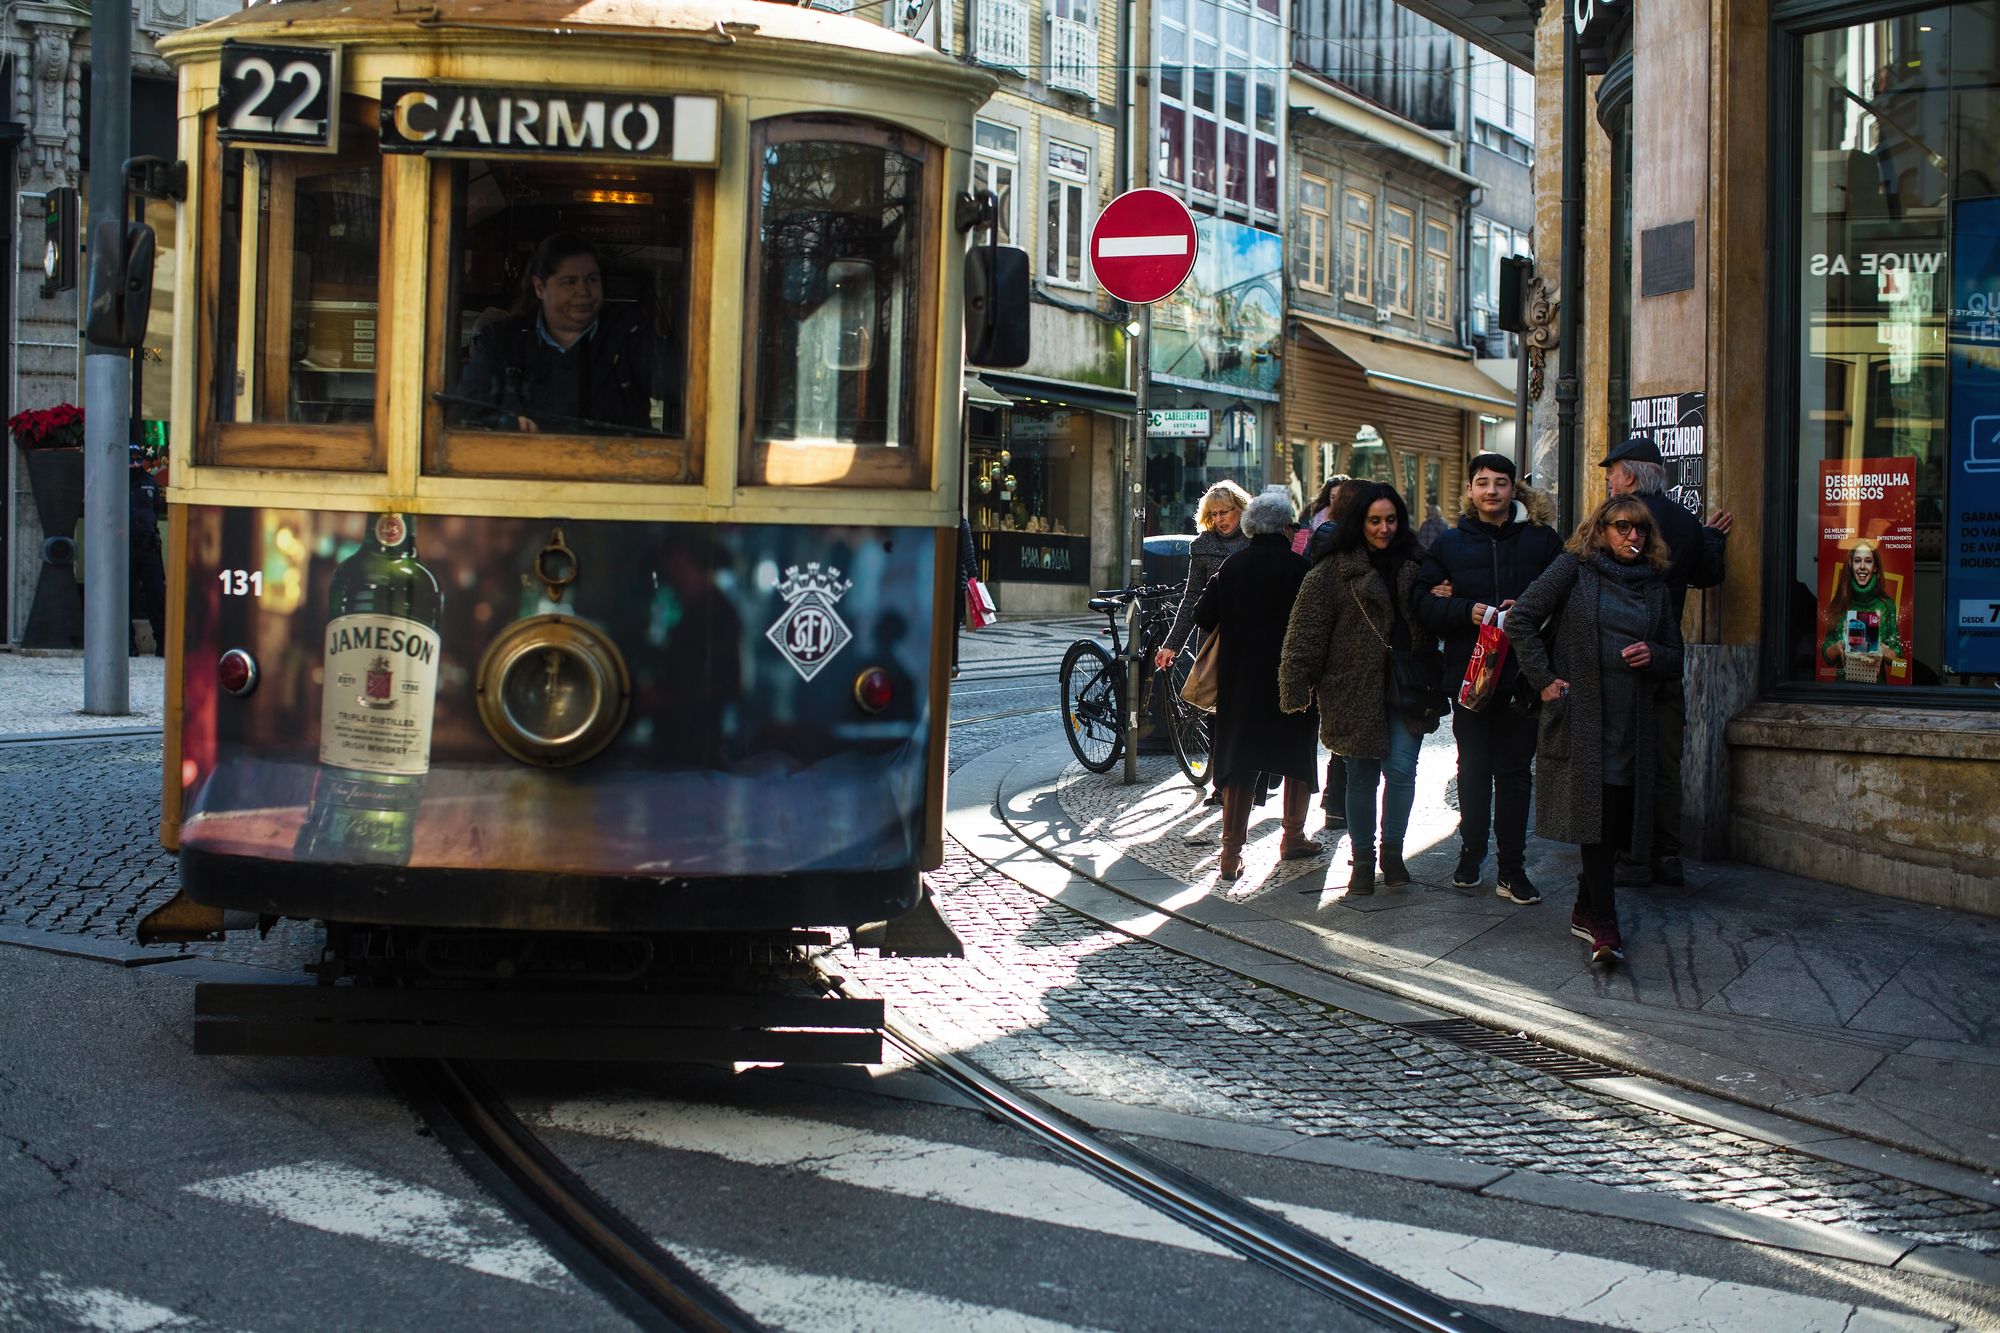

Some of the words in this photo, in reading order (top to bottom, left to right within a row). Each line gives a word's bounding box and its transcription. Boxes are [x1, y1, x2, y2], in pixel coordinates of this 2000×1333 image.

[229, 56, 326, 135] 22
[394, 91, 660, 152] CARMO
[1164, 411, 1207, 421] CABELEIREIROS
[1631, 396, 1678, 428] PROLIFERA
[1654, 425, 1704, 457] DEZEMBRO
[1825, 473, 1910, 487] DESEMBRULHA
[1825, 487, 1884, 500] SORRISOS
[1961, 527, 1979, 537] DO
[1961, 542, 1975, 552] DE
[219, 569, 263, 596] 131
[1962, 616, 1984, 624] DESDE
[330, 626, 433, 665] JAMESON
[338, 711, 367, 723] TRIPLE
[370, 715, 415, 727] DISTILLED
[341, 740, 365, 751] IRISH
[367, 744, 408, 755] WHISKEY
